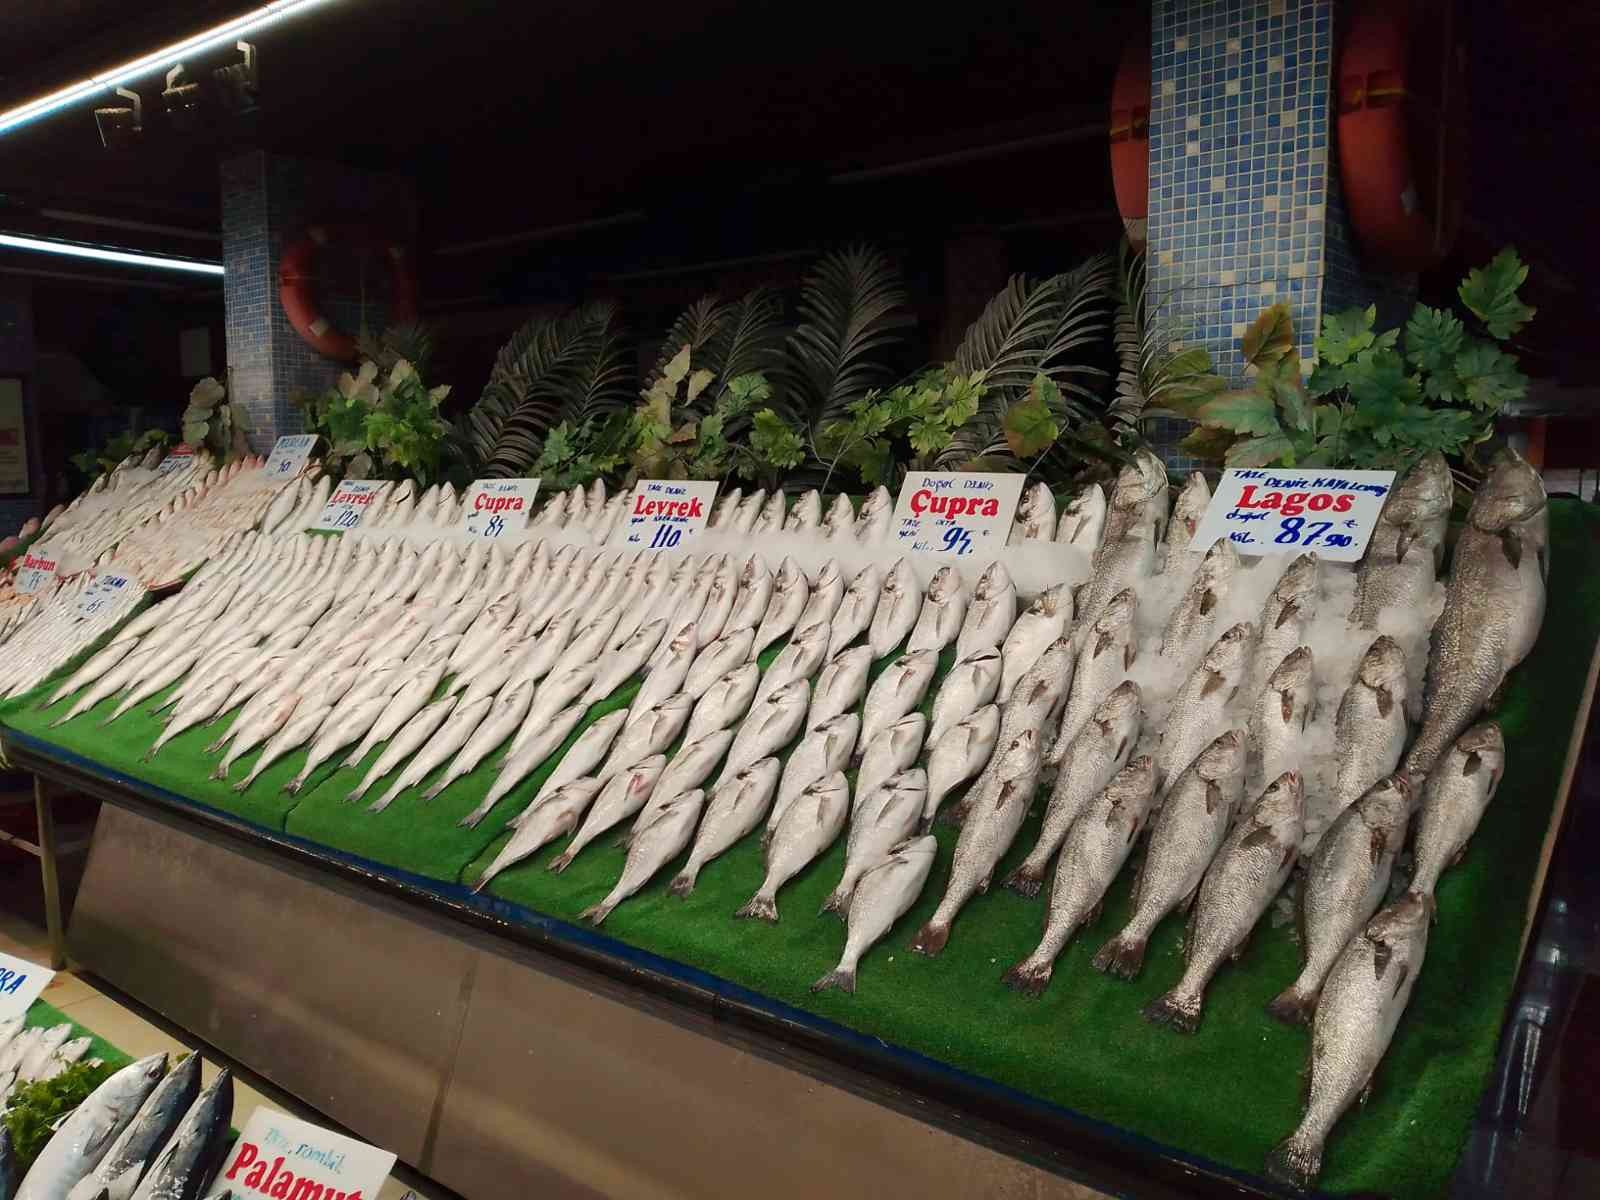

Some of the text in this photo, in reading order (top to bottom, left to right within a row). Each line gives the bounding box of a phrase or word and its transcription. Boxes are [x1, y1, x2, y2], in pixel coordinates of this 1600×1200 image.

[633, 494, 704, 517] Levrek
[910, 489, 999, 520] Çupra
[1235, 485, 1356, 517] Lagos
[484, 514, 506, 537] 85
